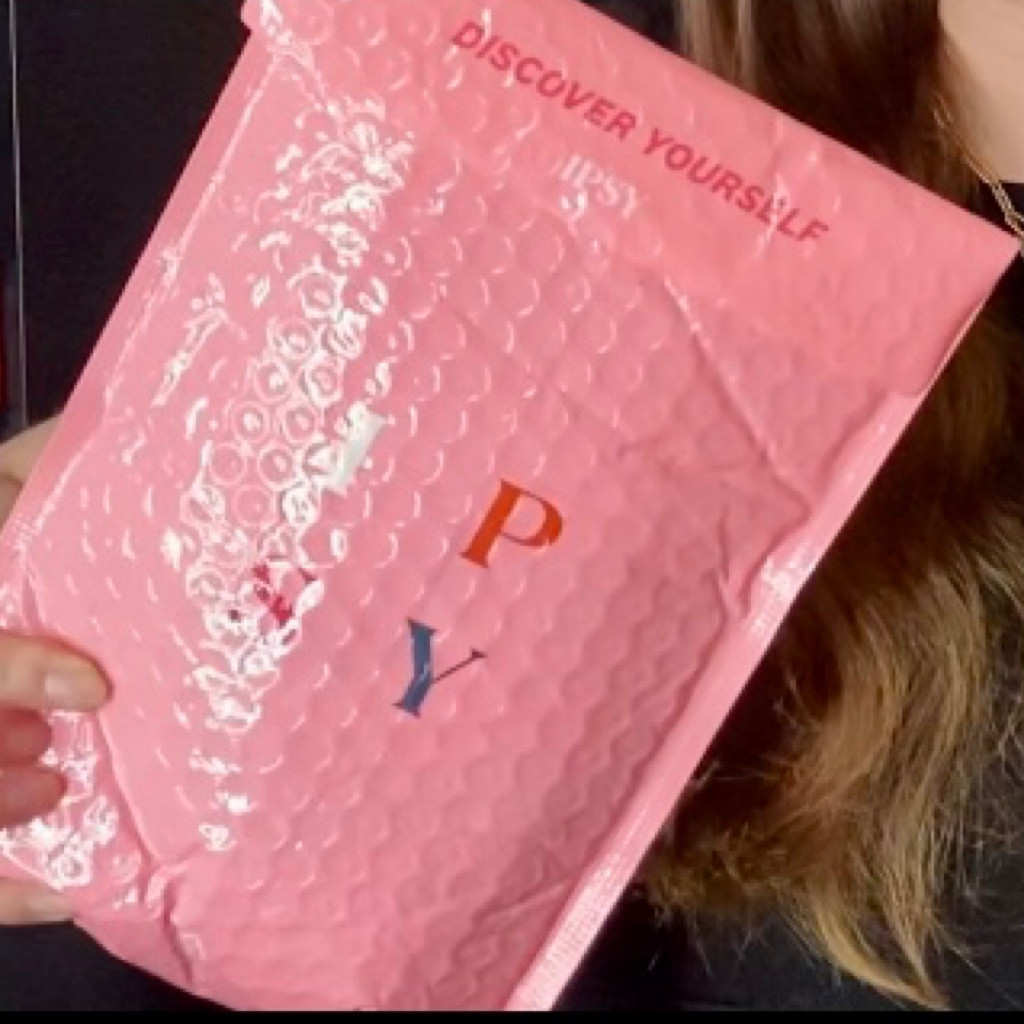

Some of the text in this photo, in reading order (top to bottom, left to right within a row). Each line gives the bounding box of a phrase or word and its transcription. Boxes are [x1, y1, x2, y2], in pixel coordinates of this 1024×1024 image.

[452, 21, 829, 242] DISCOVER YOURSELF
[460, 478, 563, 568] P
[393, 617, 487, 718] Y
